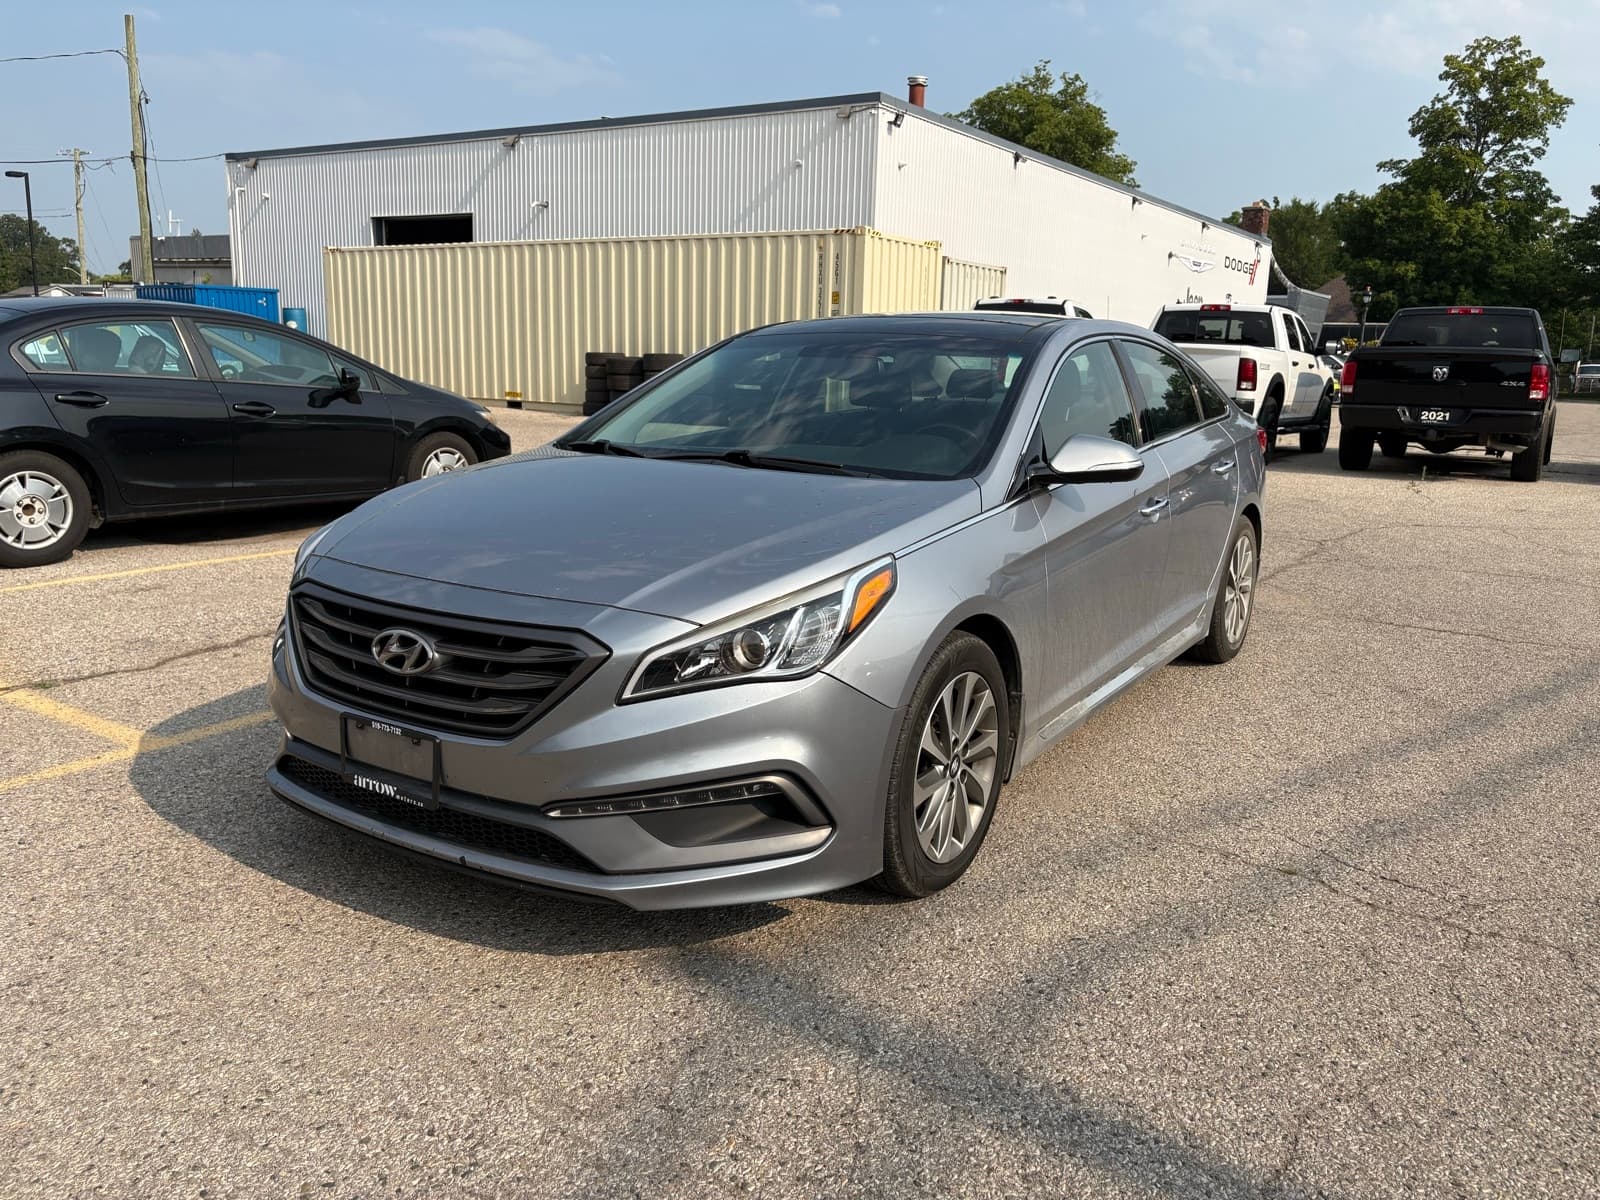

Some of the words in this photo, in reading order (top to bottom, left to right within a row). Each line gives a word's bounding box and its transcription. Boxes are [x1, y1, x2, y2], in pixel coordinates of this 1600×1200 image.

[1224, 256, 1254, 275] DODGE
[1420, 411, 1450, 421] 2021
[353, 774, 397, 797] arrow
